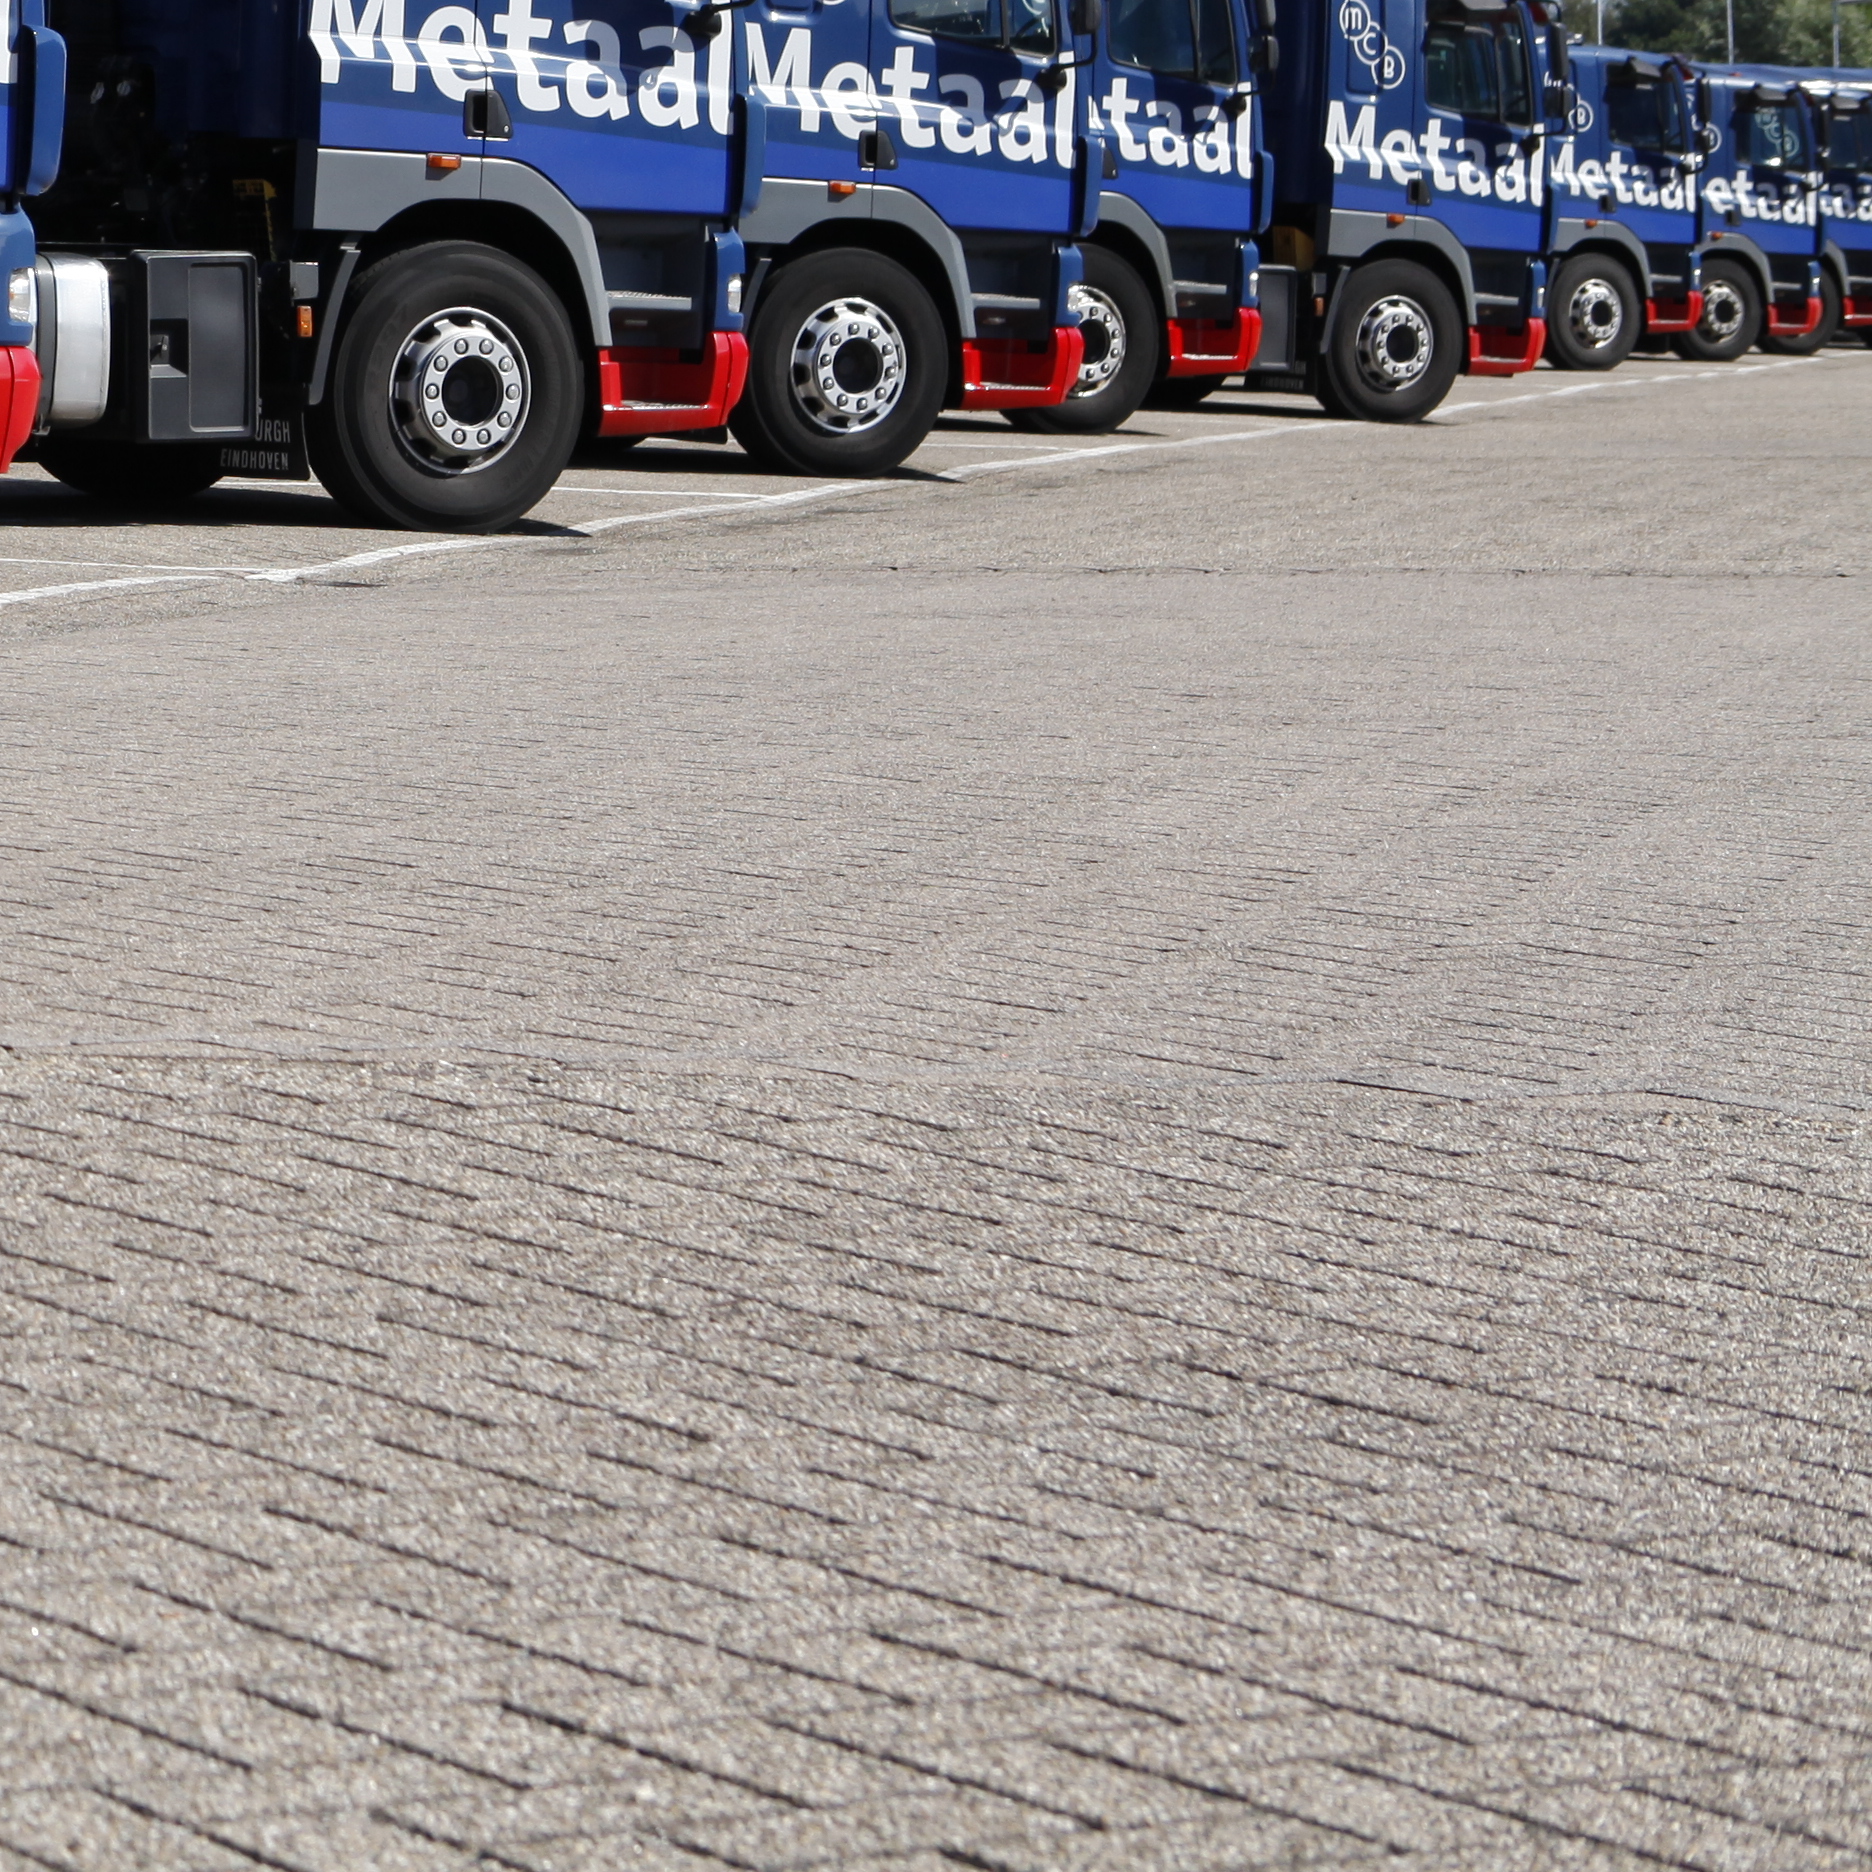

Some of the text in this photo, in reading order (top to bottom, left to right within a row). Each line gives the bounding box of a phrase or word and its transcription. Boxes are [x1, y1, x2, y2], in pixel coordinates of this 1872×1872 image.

[744, 21, 1076, 170] Metaal
[1088, 77, 1254, 181] taal
[1325, 99, 1546, 208] Metaal
[1551, 141, 1697, 214] Metaal
[221, 448, 289, 471] EINDHOVEN
